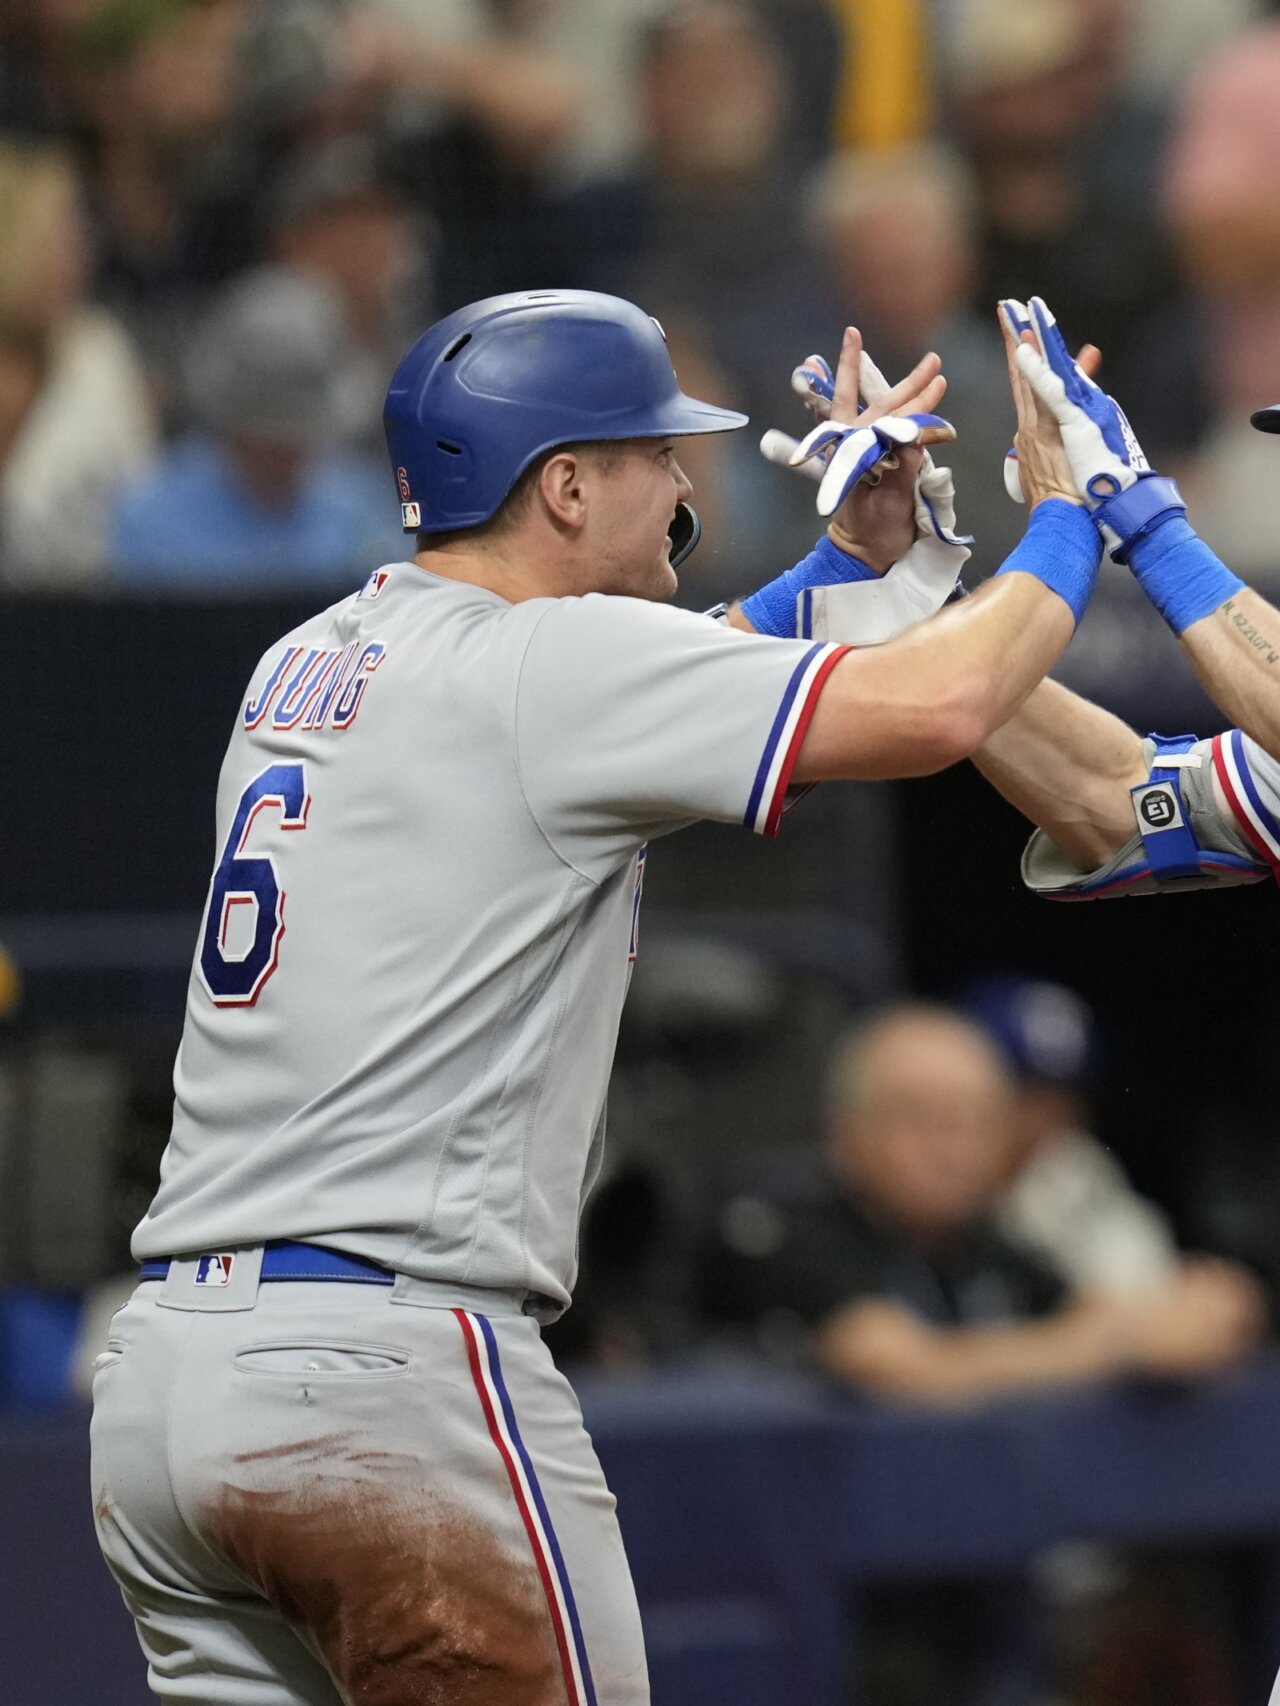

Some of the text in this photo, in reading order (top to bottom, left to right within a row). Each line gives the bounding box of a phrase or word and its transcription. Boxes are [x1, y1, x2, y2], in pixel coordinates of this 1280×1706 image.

[397, 466, 411, 502] 6
[244, 639, 387, 731] JUNG
[195, 758, 312, 1009] 6
